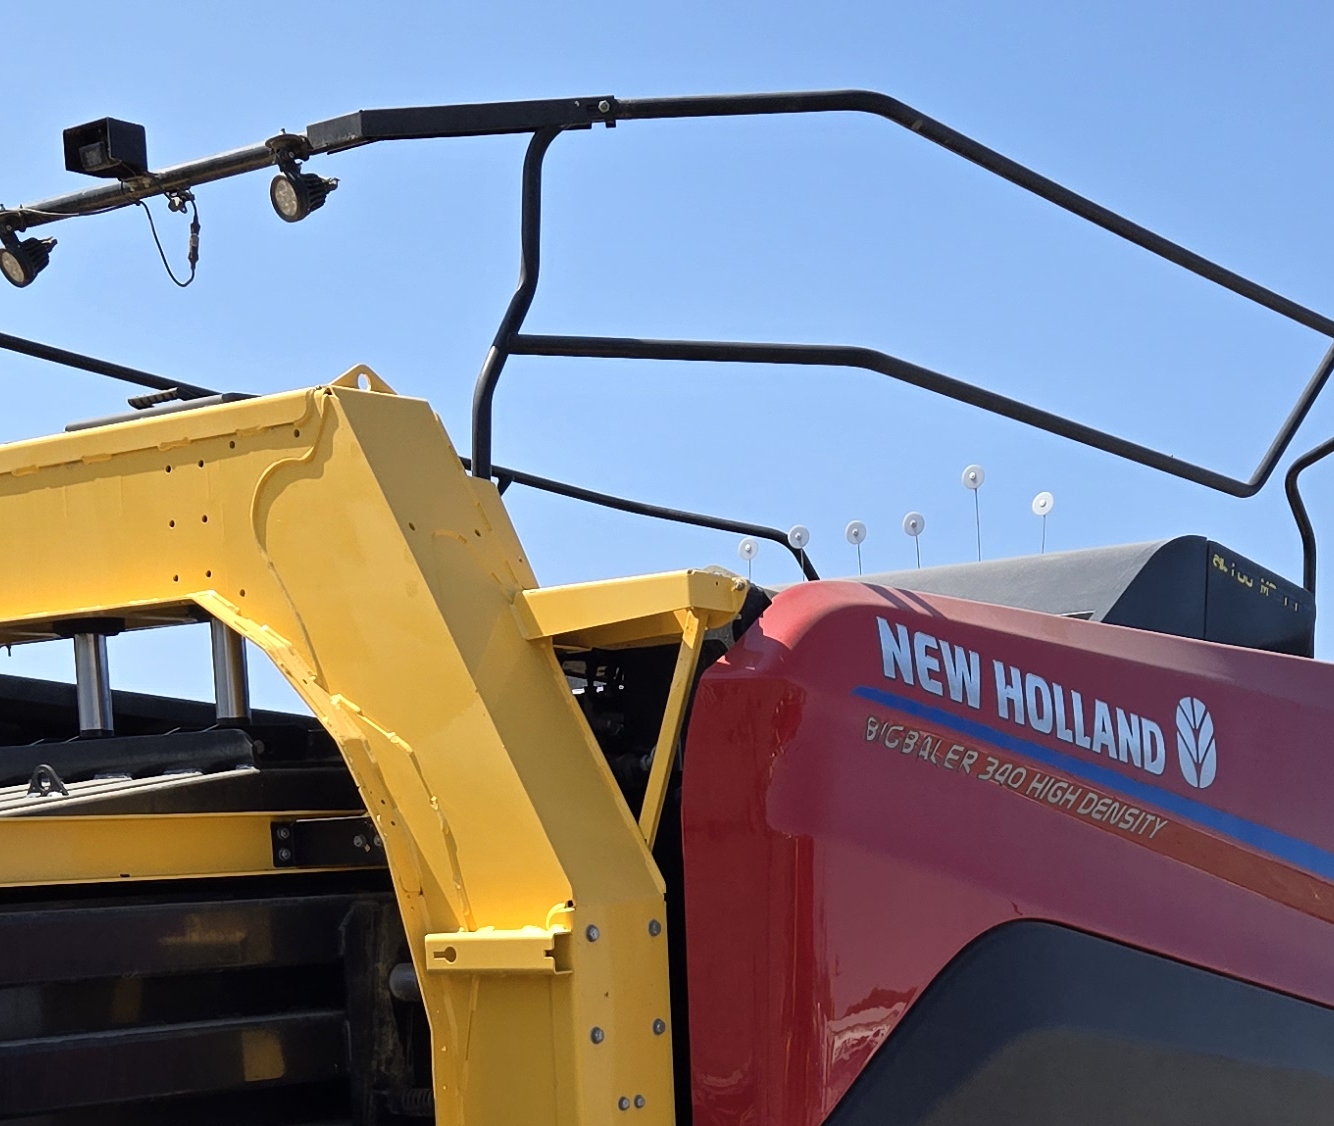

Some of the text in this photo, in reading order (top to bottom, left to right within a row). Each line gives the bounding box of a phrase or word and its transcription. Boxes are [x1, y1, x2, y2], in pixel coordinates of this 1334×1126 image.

[876, 616, 1166, 776] NEW HOLLAND
[865, 716, 1168, 839] BIGBALER 340 HIGH DENSITY
